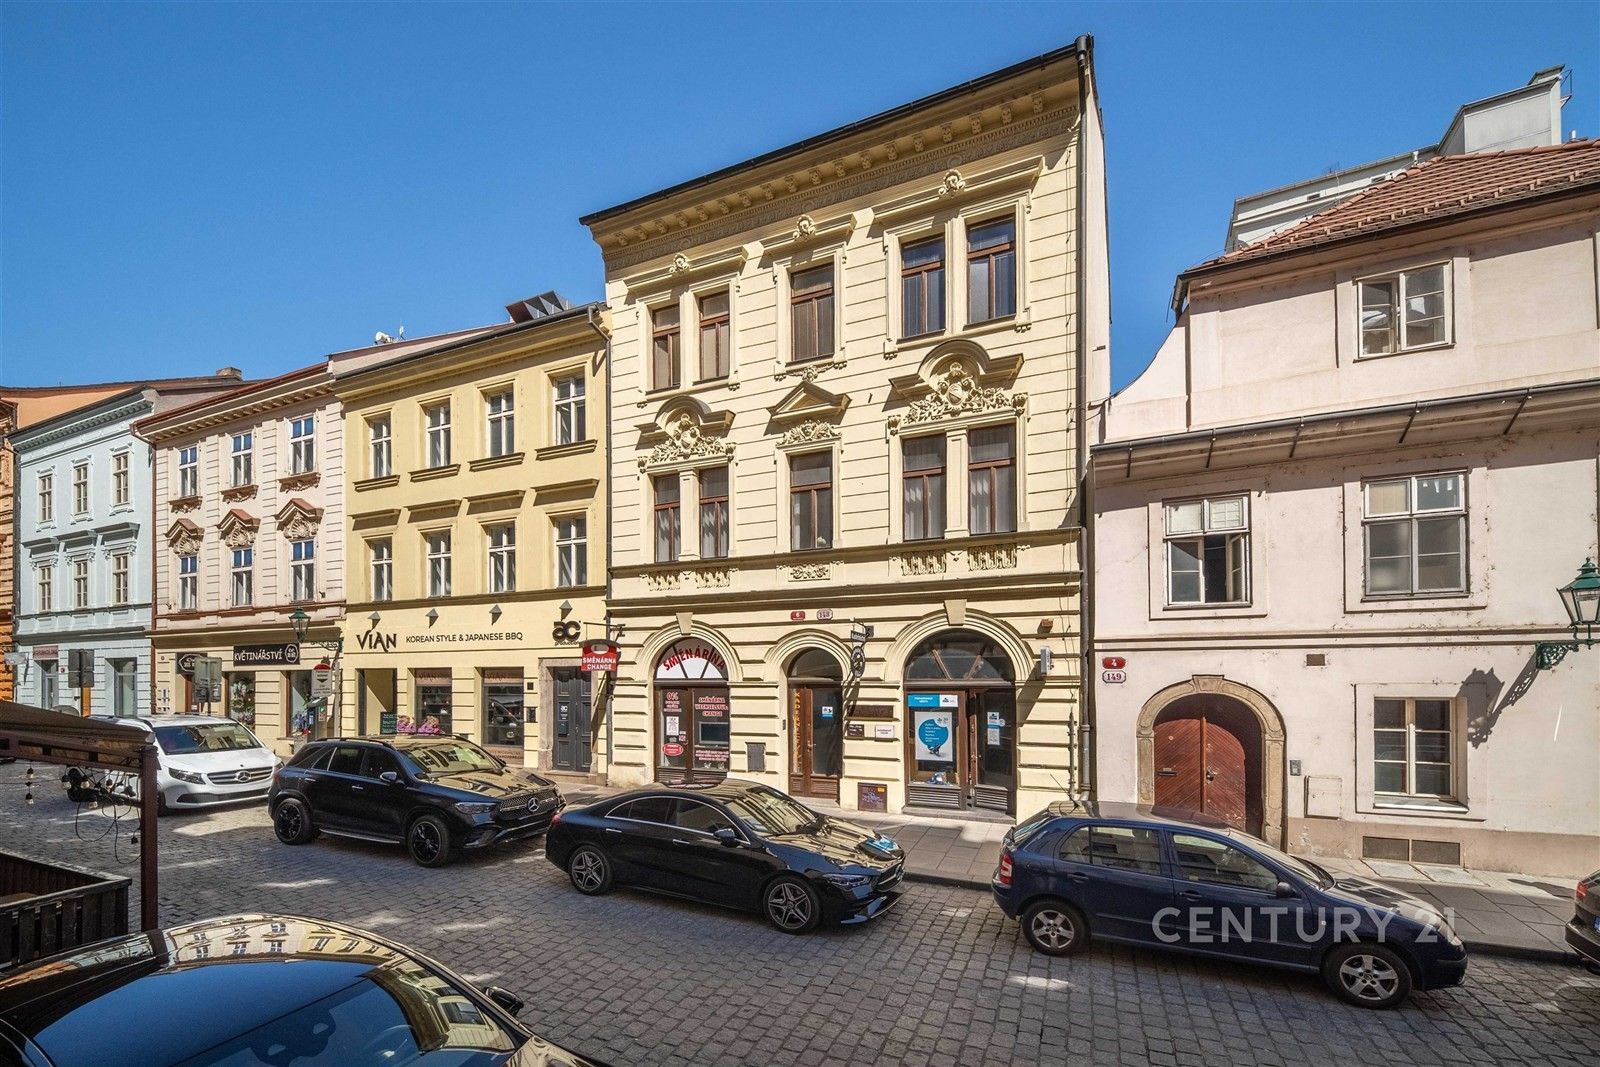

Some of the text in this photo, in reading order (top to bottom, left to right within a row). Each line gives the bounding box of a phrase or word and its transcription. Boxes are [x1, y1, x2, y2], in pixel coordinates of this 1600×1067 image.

[356, 629, 397, 653] VIAN
[406, 635, 435, 643] KOREAN
[436, 634, 457, 642] STYLE
[465, 632, 504, 641] JAPANESE
[505, 632, 523, 640] BBQ
[234, 648, 283, 661] KVĚTINÁŘSTVÍ
[582, 656, 617, 664] SMĚNÁRNA
[1106, 673, 1122, 681] 149
